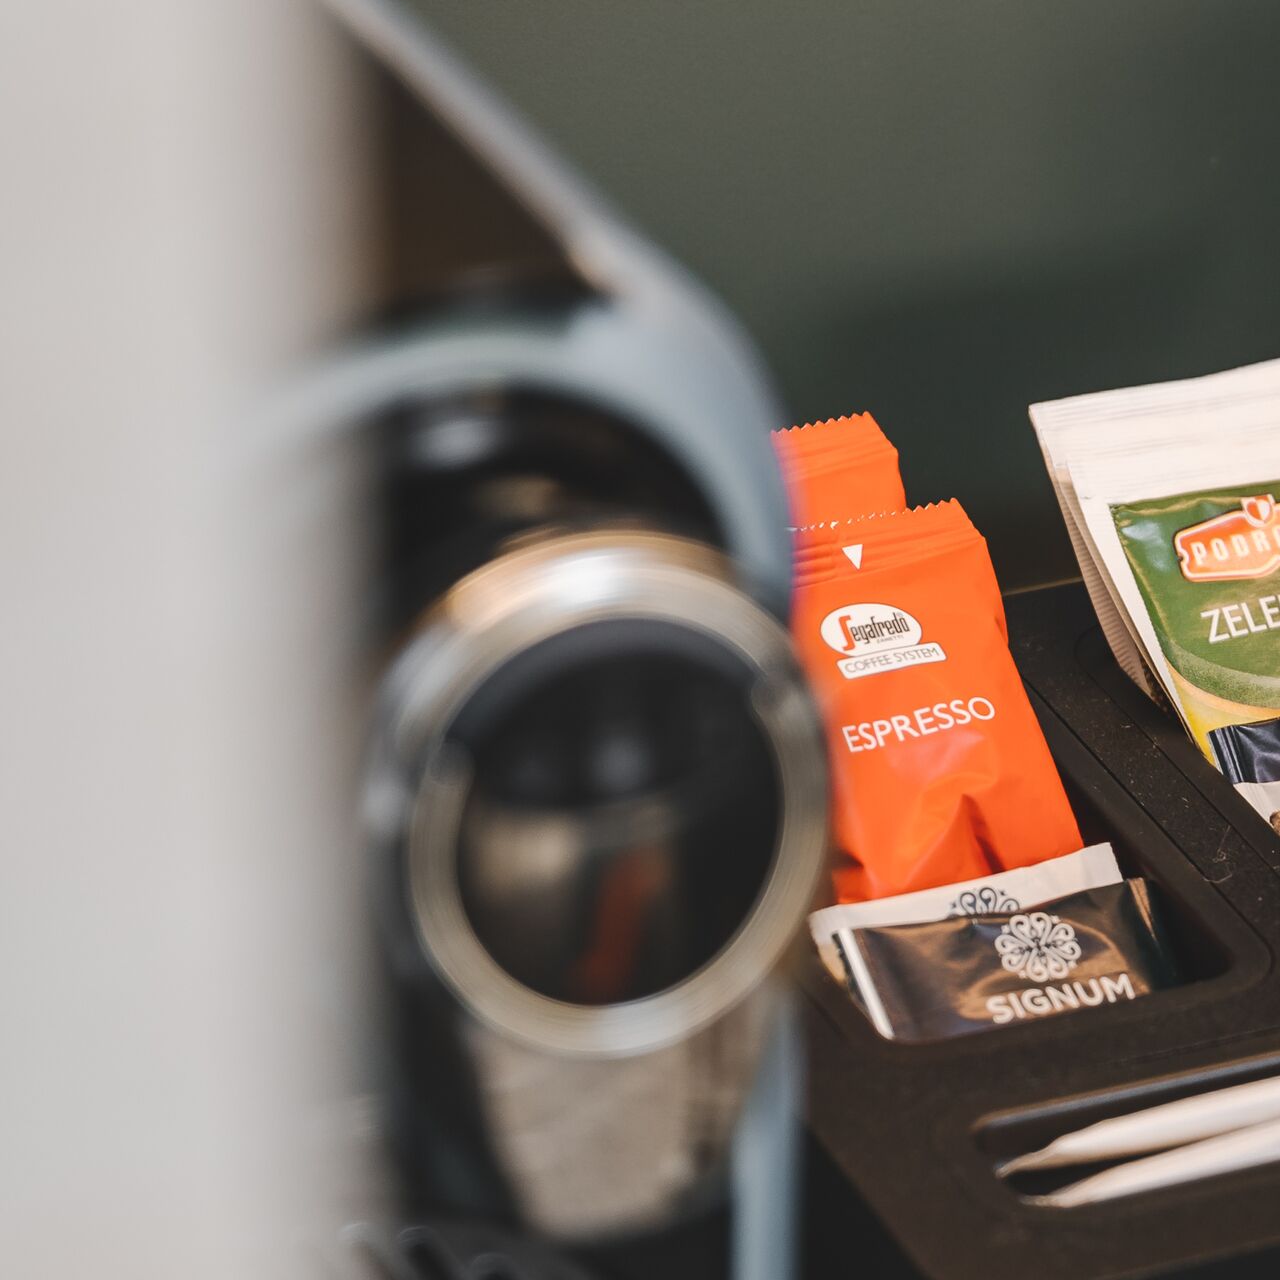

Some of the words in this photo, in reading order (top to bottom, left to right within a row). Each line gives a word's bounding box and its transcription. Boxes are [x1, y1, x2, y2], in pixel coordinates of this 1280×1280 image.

[838, 612, 910, 651] Segafredo
[844, 654, 893, 673] COFFEE
[893, 647, 940, 663] SYSTEM
[841, 696, 996, 753] ESPRESSO
[985, 973, 1136, 1024] SIGNUM
